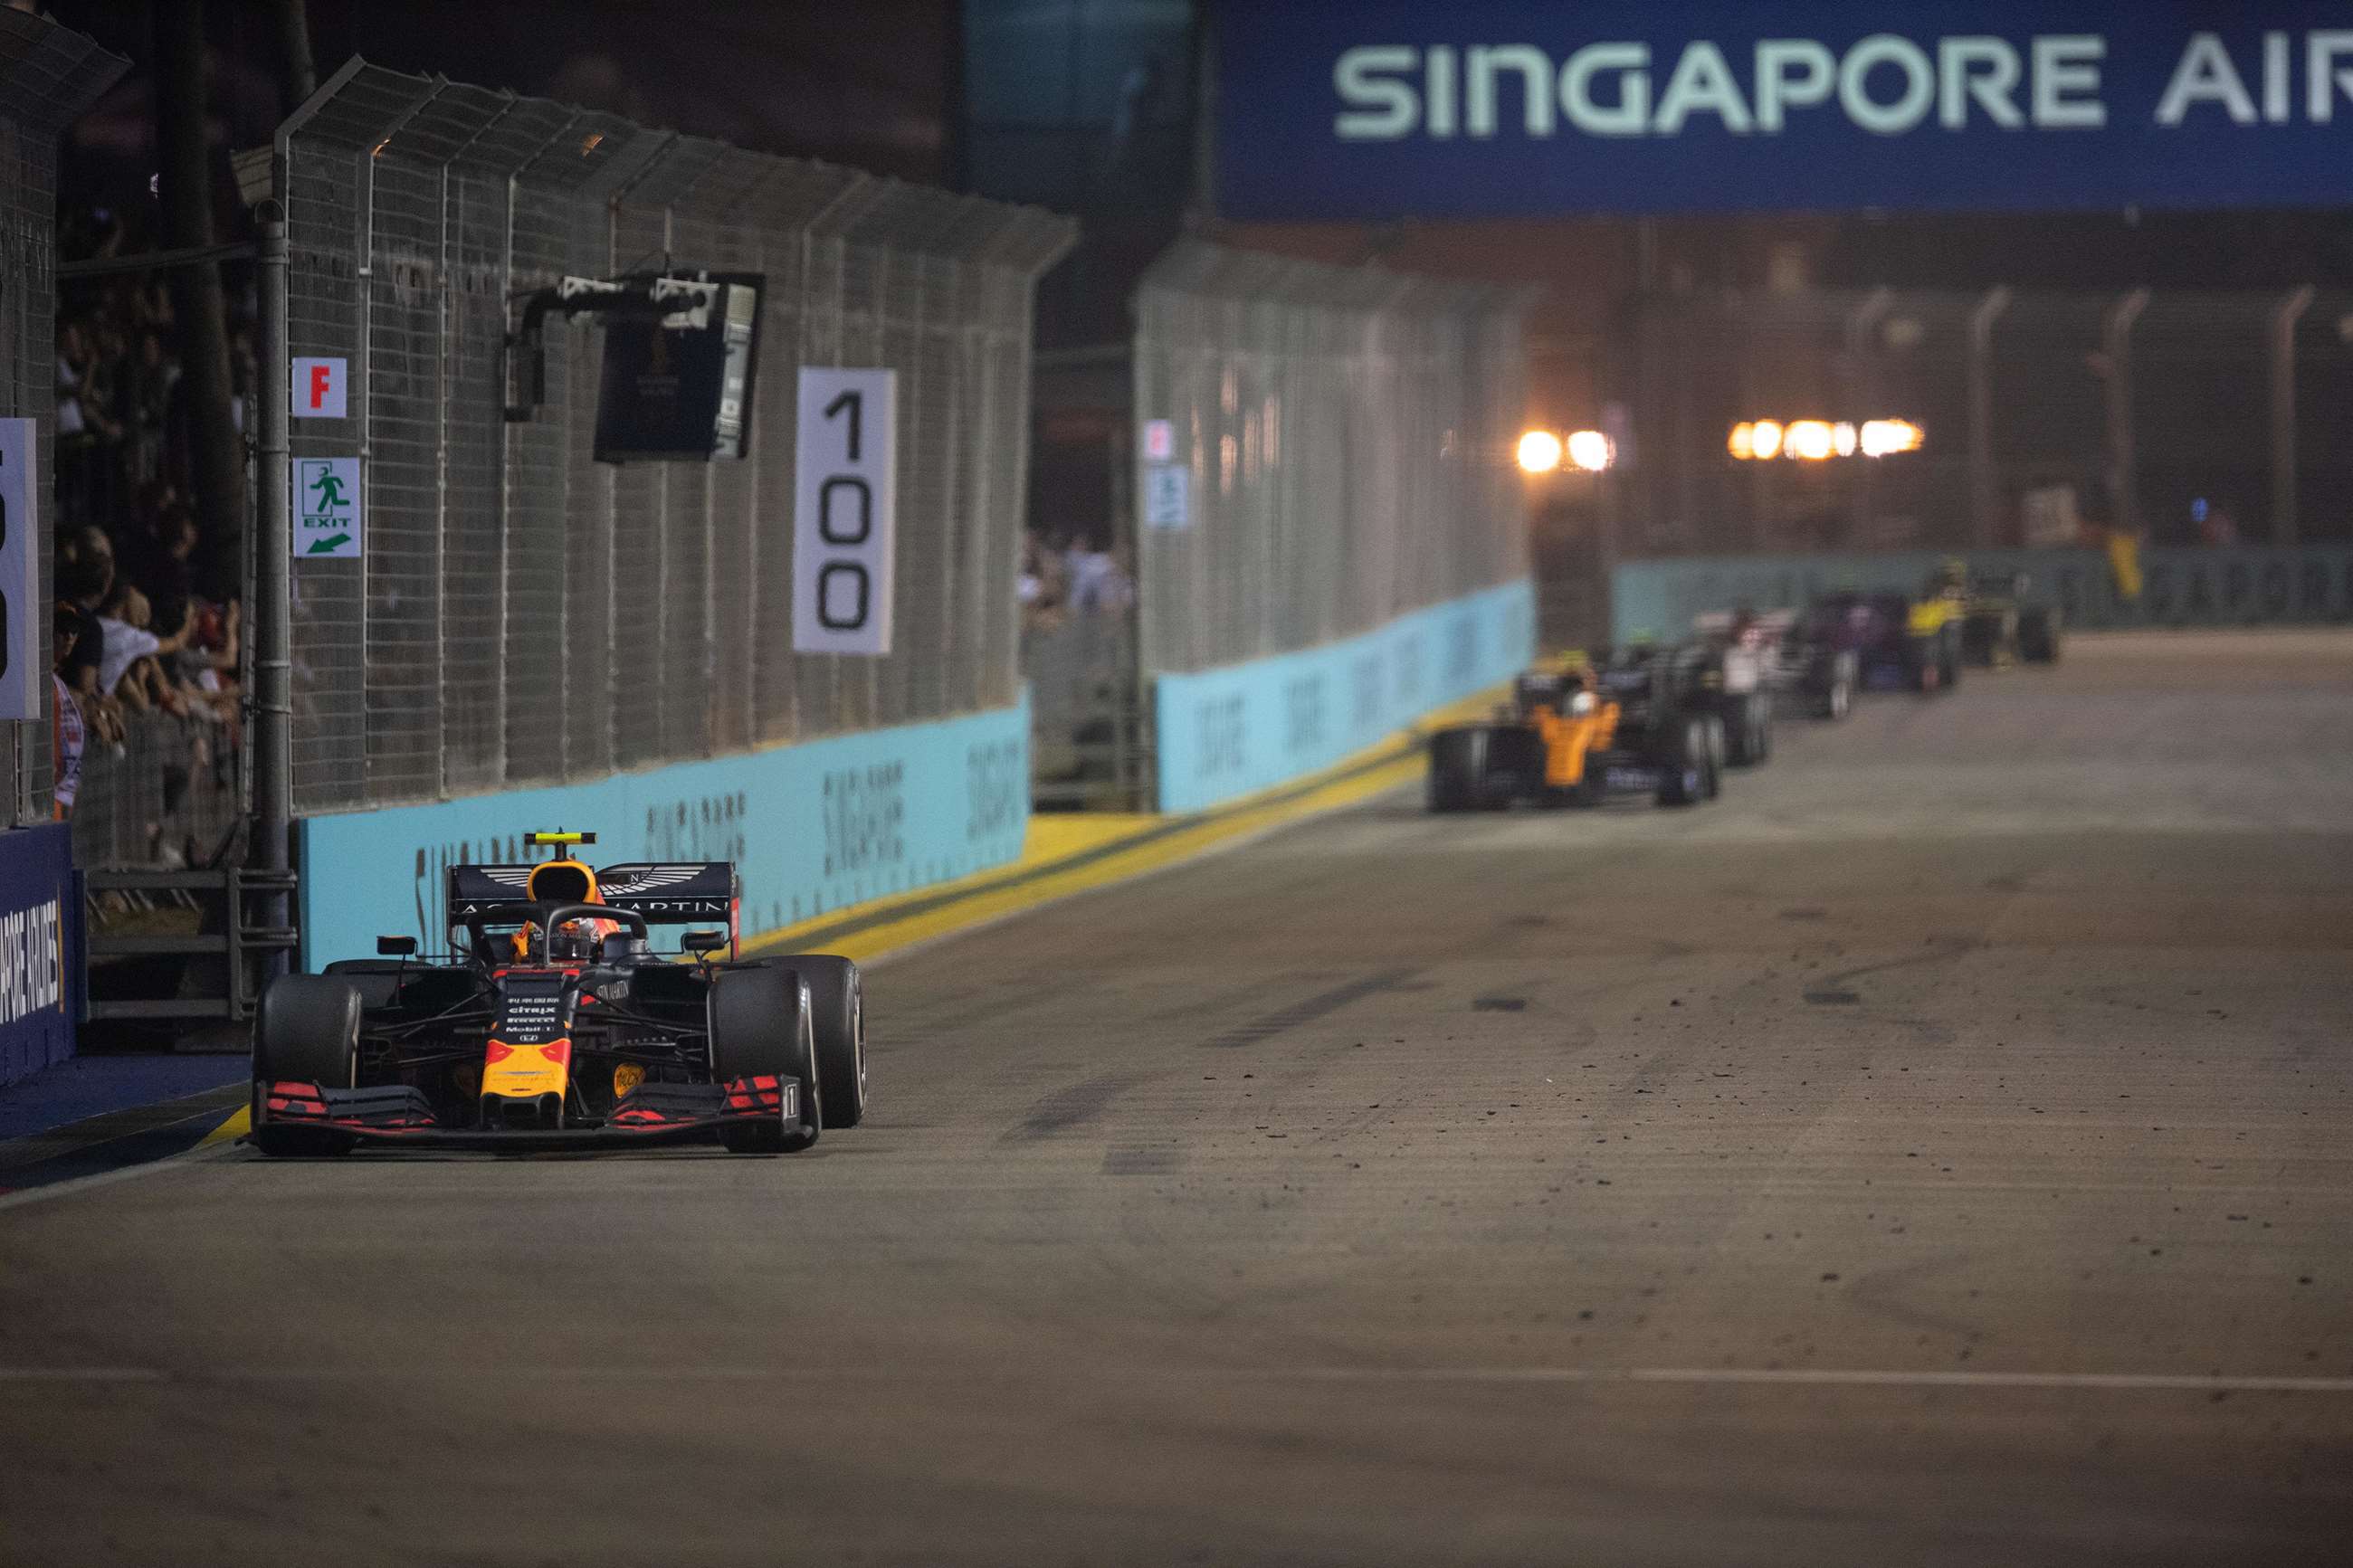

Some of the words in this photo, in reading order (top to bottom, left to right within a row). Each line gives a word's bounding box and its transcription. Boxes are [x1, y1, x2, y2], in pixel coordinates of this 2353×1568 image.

[1334, 34, 2107, 138] SINGAPORE
[310, 366, 329, 408] F
[303, 518, 351, 528] EXIT
[818, 390, 873, 632] 100
